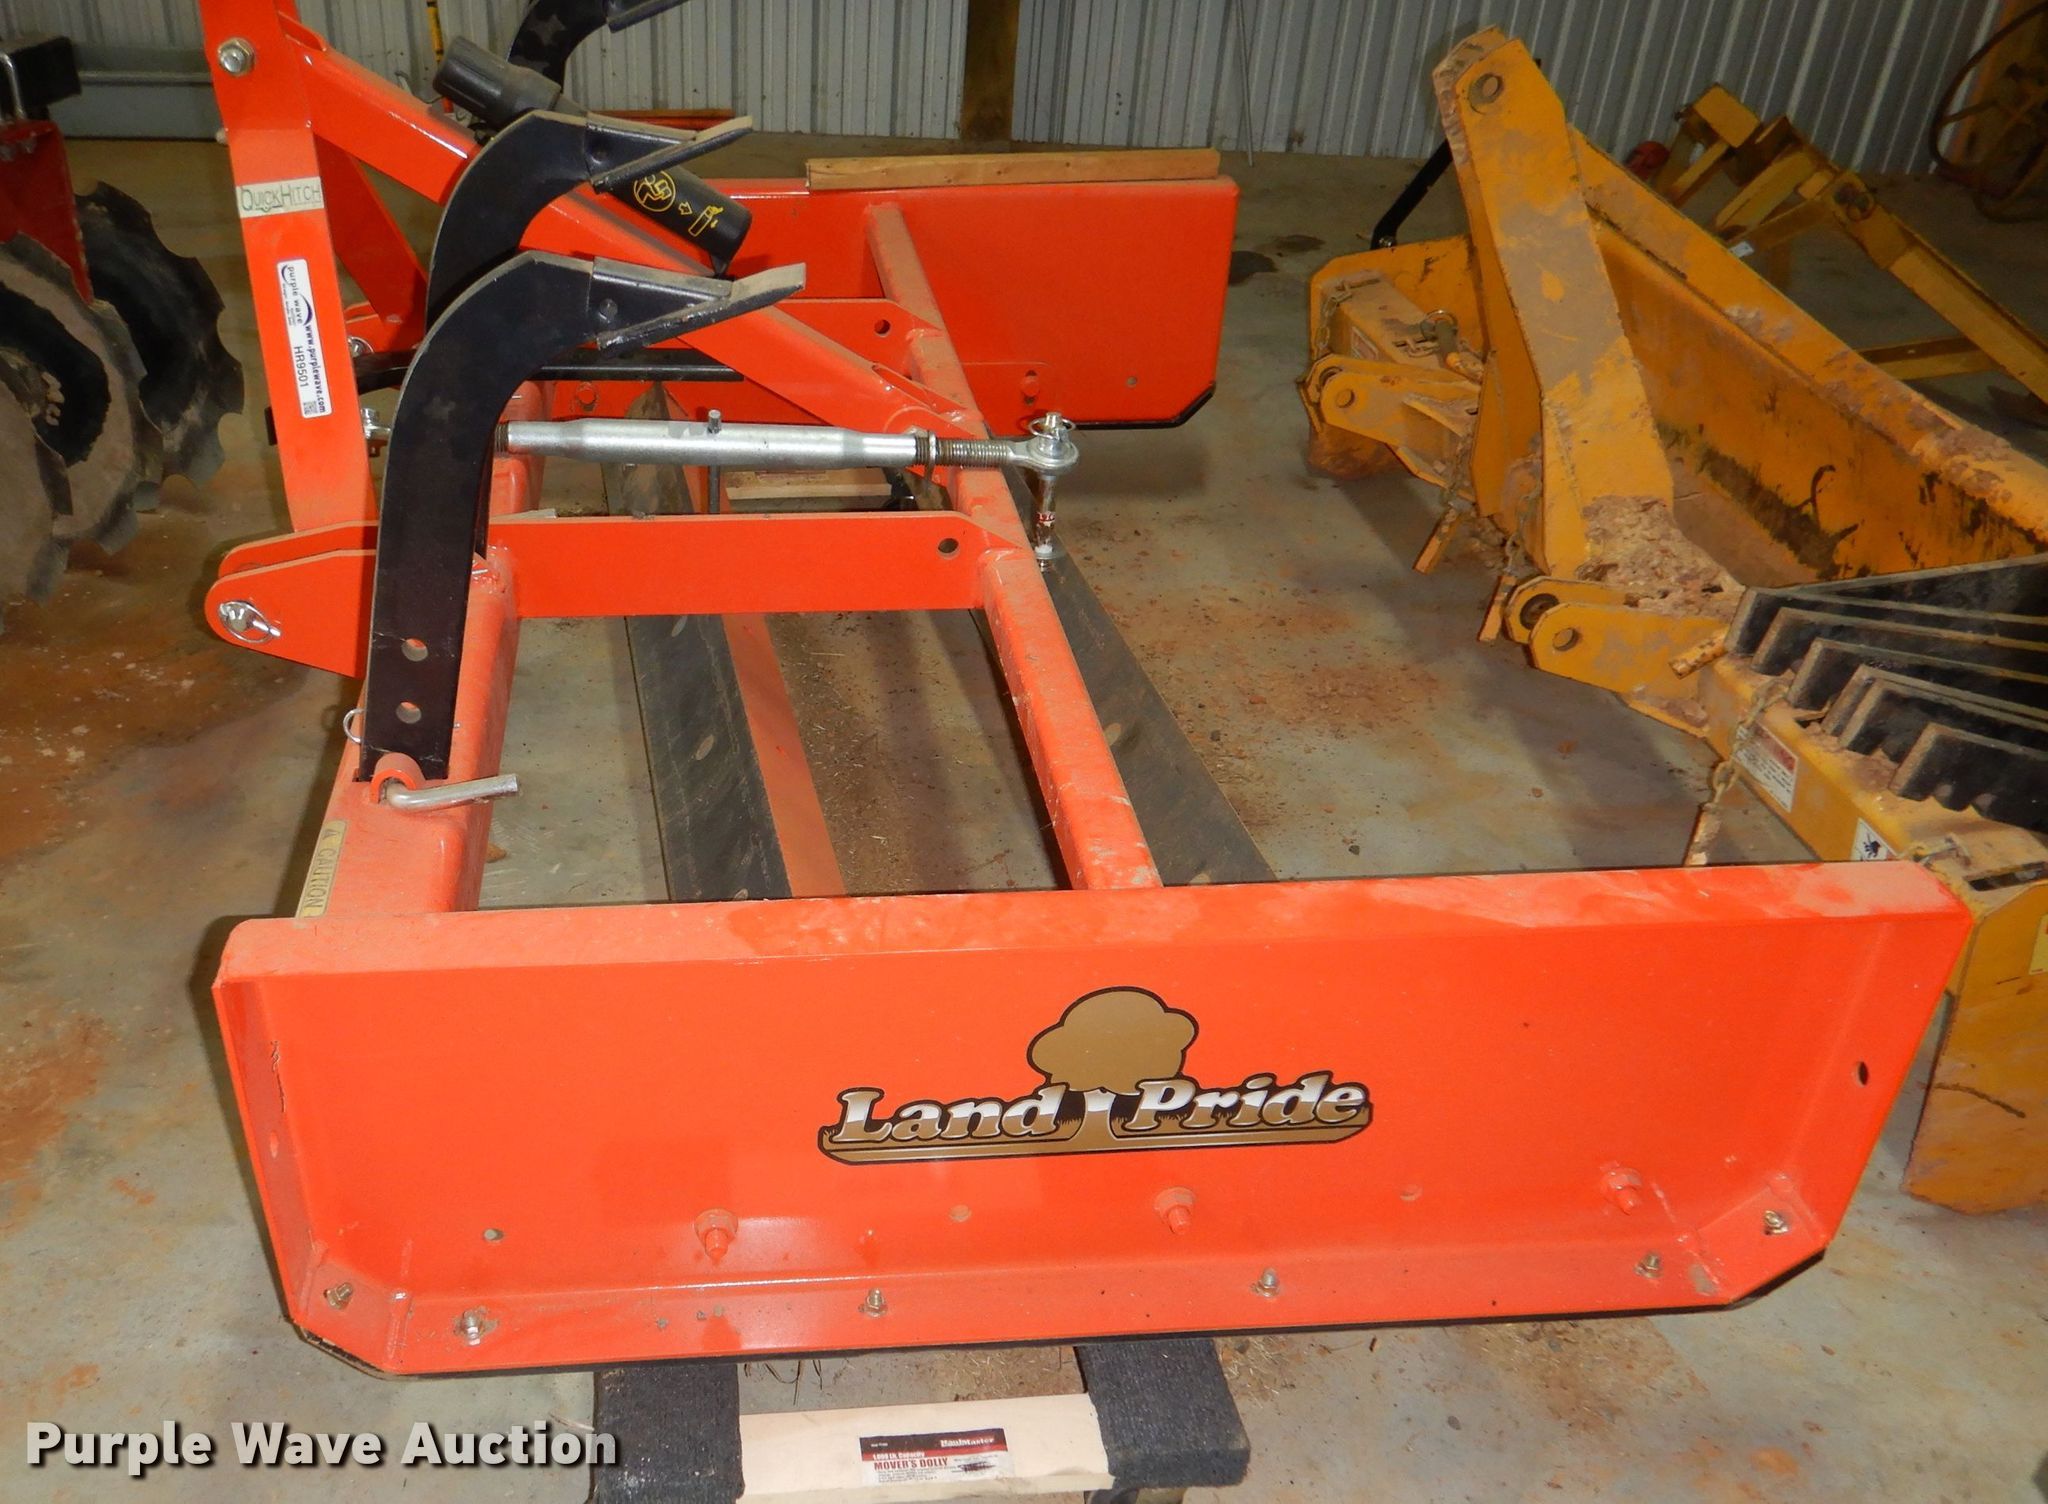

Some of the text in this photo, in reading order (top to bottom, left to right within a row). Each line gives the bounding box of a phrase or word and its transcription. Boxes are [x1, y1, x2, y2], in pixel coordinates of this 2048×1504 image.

[287, 266, 299, 296] purple
[294, 299, 303, 324] wave
[294, 346, 309, 387] HR9501
[305, 325, 326, 413] www.purplewave.com
[303, 848, 336, 908] CAUTION
[829, 1072, 1369, 1142] Land Pride
[874, 1459, 918, 1471] MOVER'S
[919, 1457, 949, 1468] DOLLY
